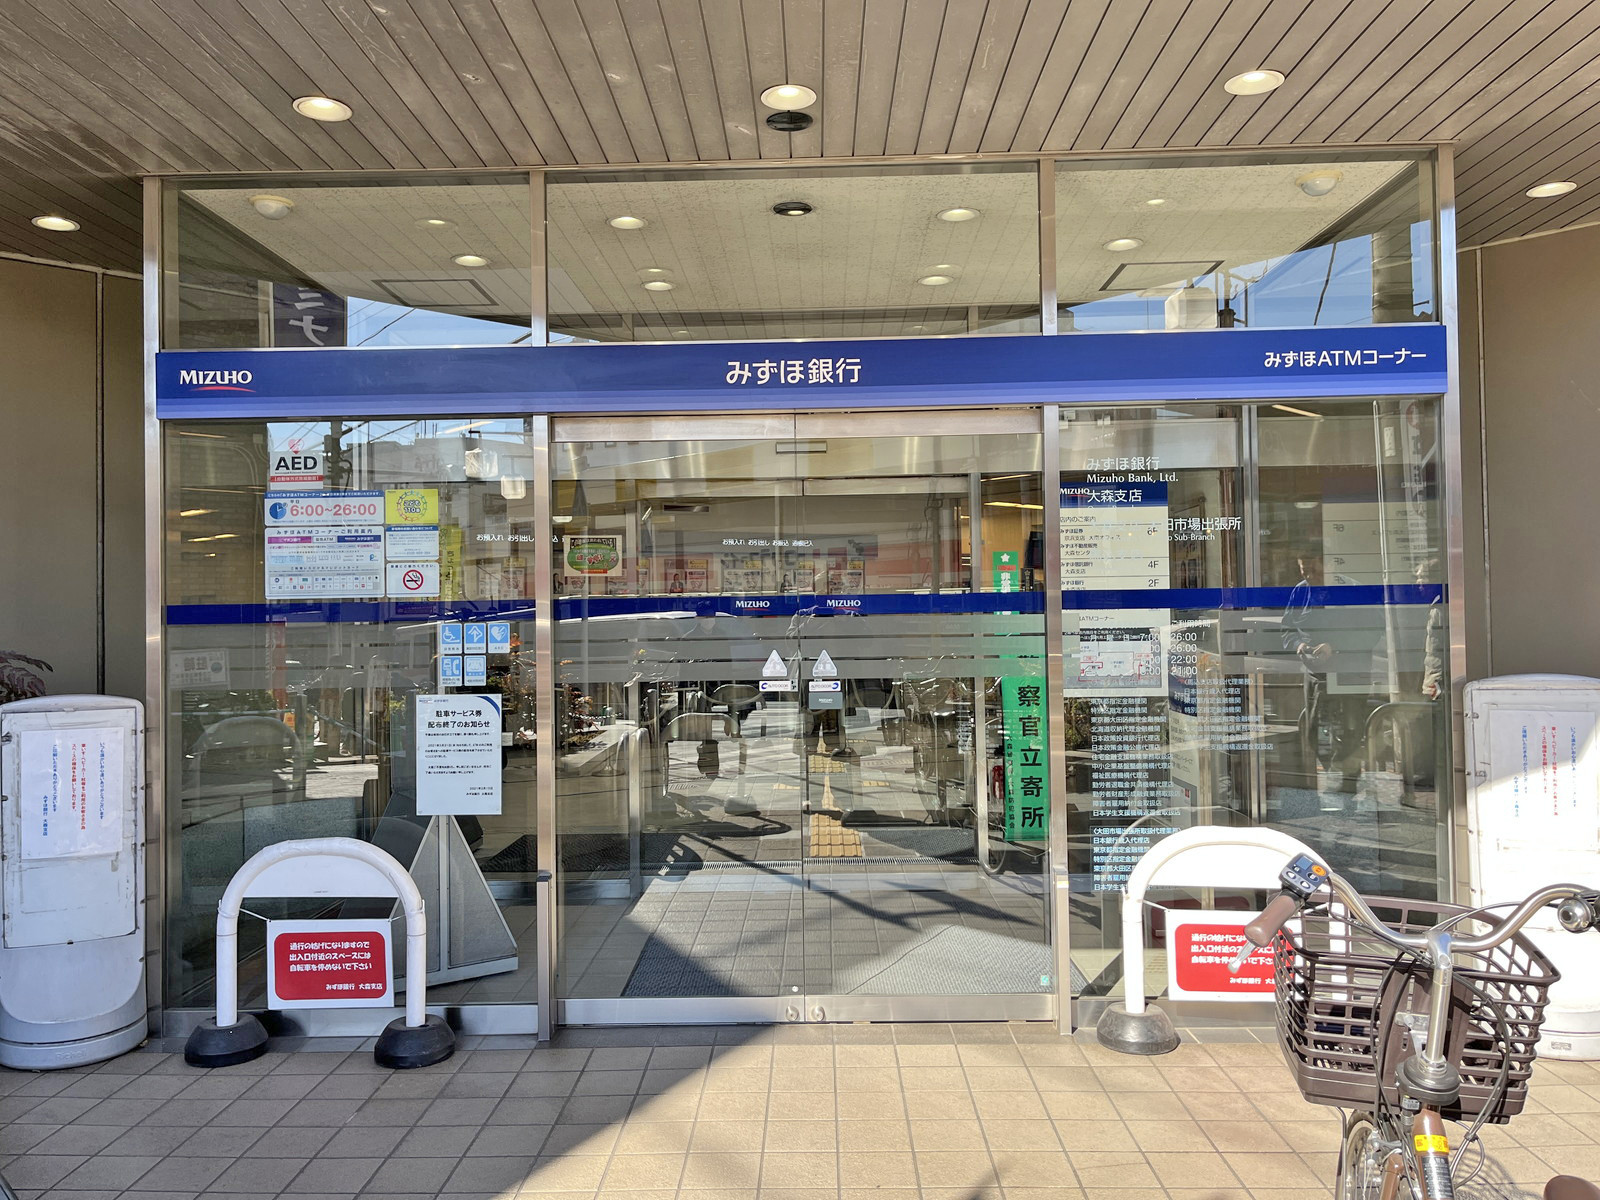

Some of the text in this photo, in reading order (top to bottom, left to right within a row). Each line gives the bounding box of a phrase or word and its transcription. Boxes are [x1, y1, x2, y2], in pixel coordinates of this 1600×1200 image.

[1264, 348, 1427, 368] みずほATMコーナー
[725, 357, 862, 385] みずほ銀行
[179, 369, 253, 385] MIZUHO
[275, 456, 318, 471] AED
[1086, 456, 1160, 471] みずほ銀行
[1086, 472, 1179, 483] Mizuho Bank, Ltd.
[1059, 487, 1091, 496] MIZUHO
[1087, 488, 1142, 503] 大森支店
[476, 533, 535, 542] お預入れ お引出し
[1174, 533, 1216, 541] Sub-Branch
[722, 538, 745, 546] お預入れ
[1147, 560, 1159, 569] 4F
[1148, 579, 1159, 587] 2F
[735, 600, 770, 608] MIZUHO
[826, 599, 862, 608] MIZUHO
[1170, 632, 1197, 641] 26:00
[1170, 644, 1197, 653] 26:00
[1170, 655, 1198, 664] 22:00
[435, 709, 483, 718] 駐車サービス券
[427, 720, 490, 729] 配布終了のお知らせ
[1016, 655, 1045, 829] 察官立寄所
[289, 941, 370, 951] 通行の妨げになりますので
[289, 952, 372, 962] 出入口付近のスペースには
[289, 962, 373, 972] 自転車を停めないで下さい
[1229, 977, 1262, 985] みずほ銀行
[358, 982, 383, 990] 大森支店
